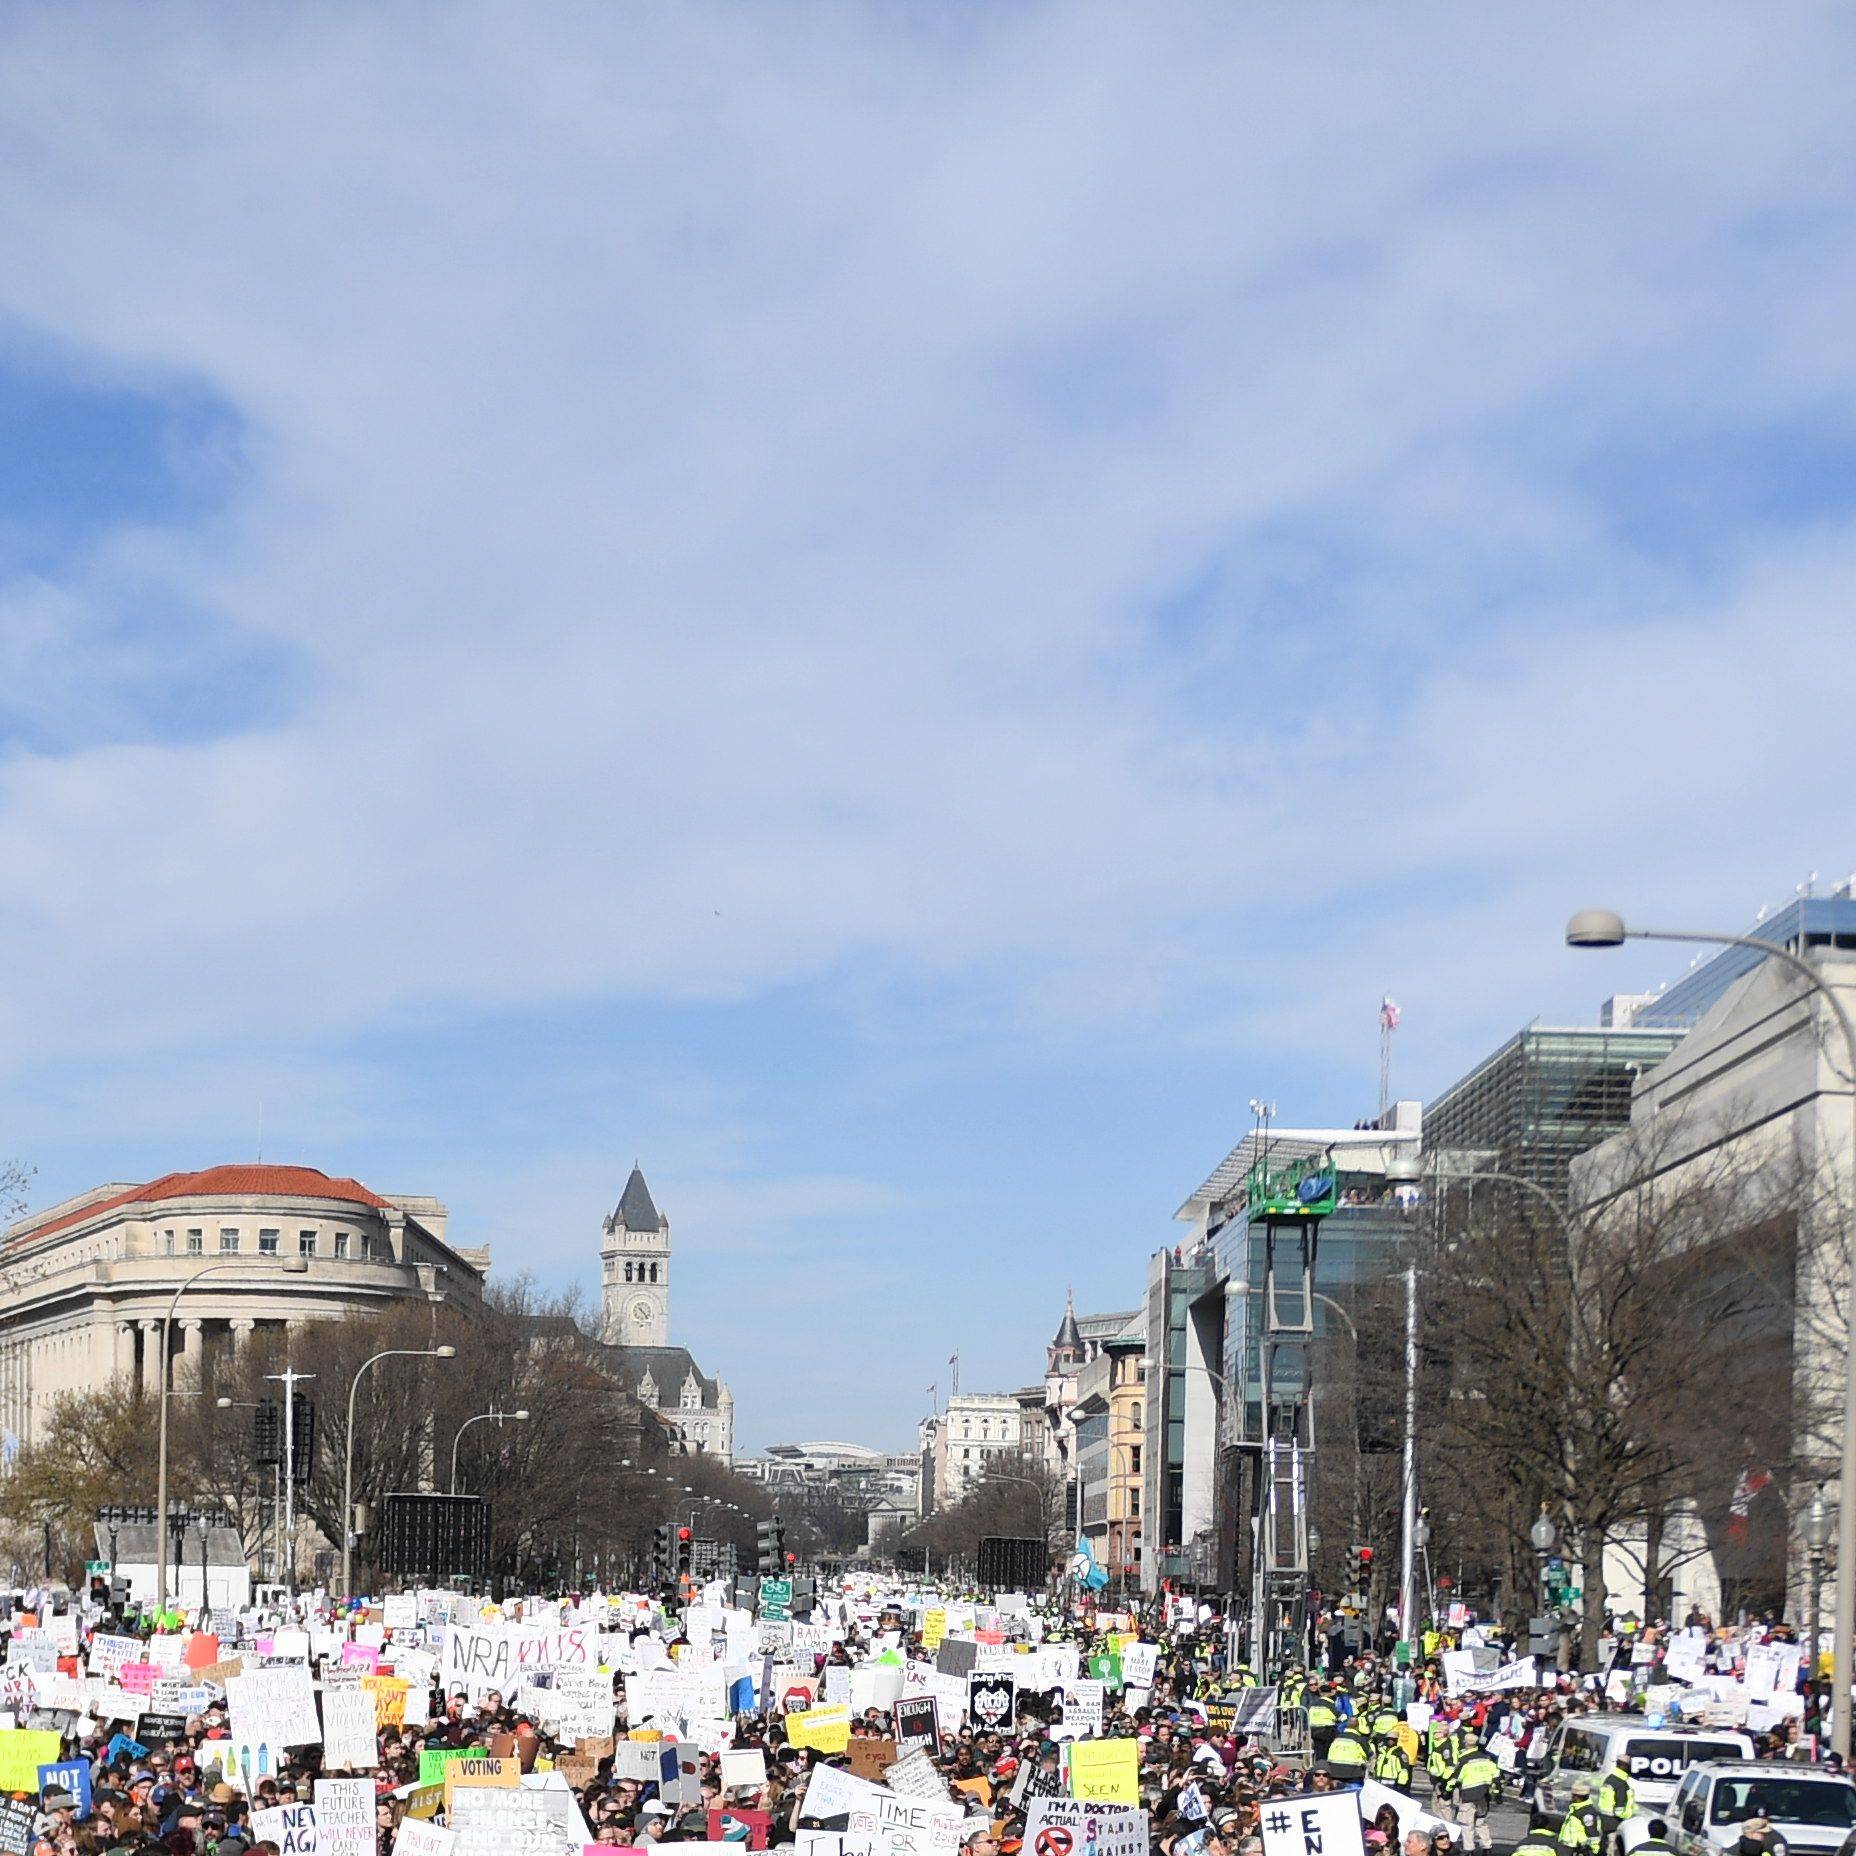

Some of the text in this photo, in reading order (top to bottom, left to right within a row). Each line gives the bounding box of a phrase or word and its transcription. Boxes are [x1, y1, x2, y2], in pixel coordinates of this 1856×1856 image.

[453, 1634, 509, 1680] NRA
[461, 1760, 502, 1776] VOTING
[330, 1783, 359, 1795] THIS
[322, 1798, 365, 1810] FUTURE
[320, 1812, 369, 1825] TEACHER
[871, 1794, 926, 1829] TIME
